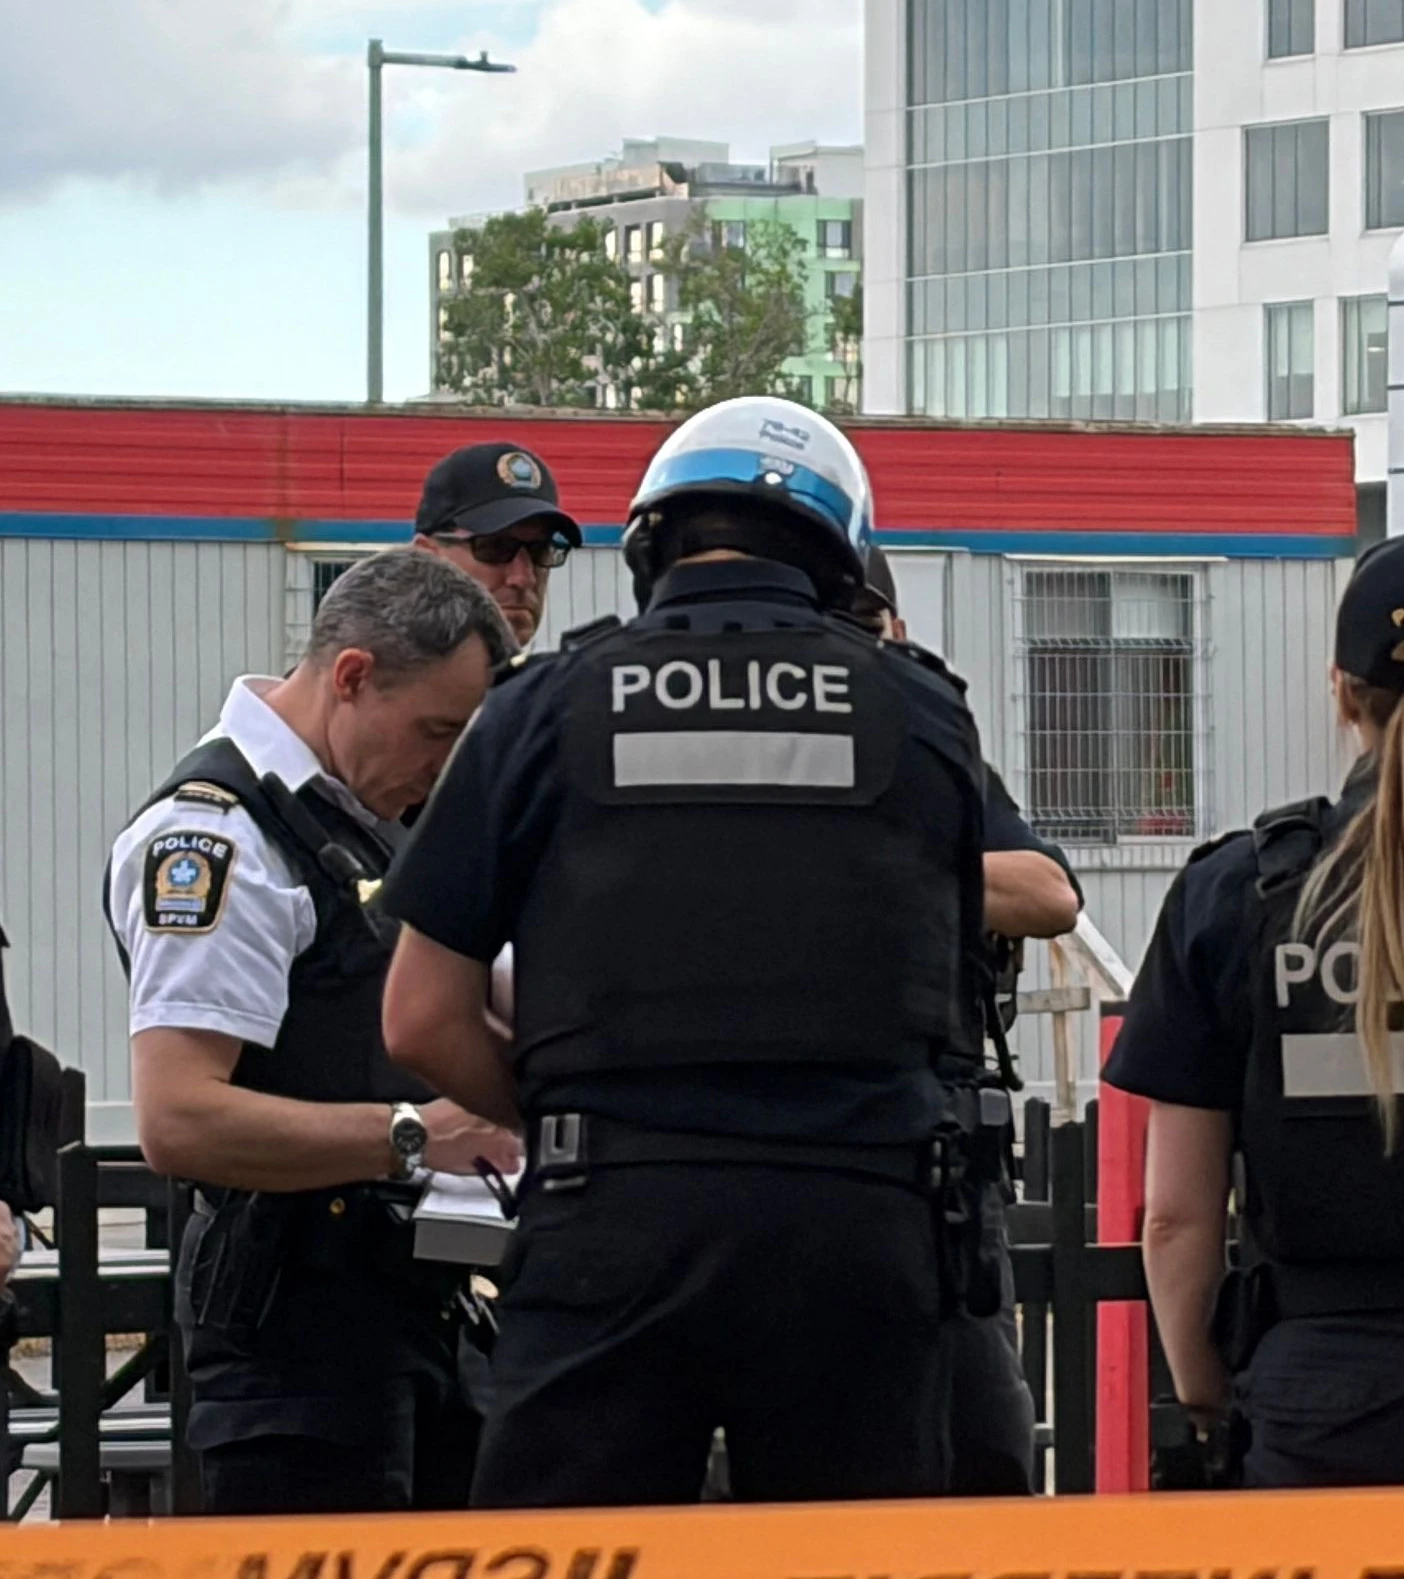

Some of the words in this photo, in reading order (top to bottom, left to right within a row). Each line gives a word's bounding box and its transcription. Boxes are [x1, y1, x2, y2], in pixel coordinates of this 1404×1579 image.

[611, 658, 853, 713] POLICE
[152, 835, 229, 860] POLICE
[158, 913, 198, 926] SPVM
